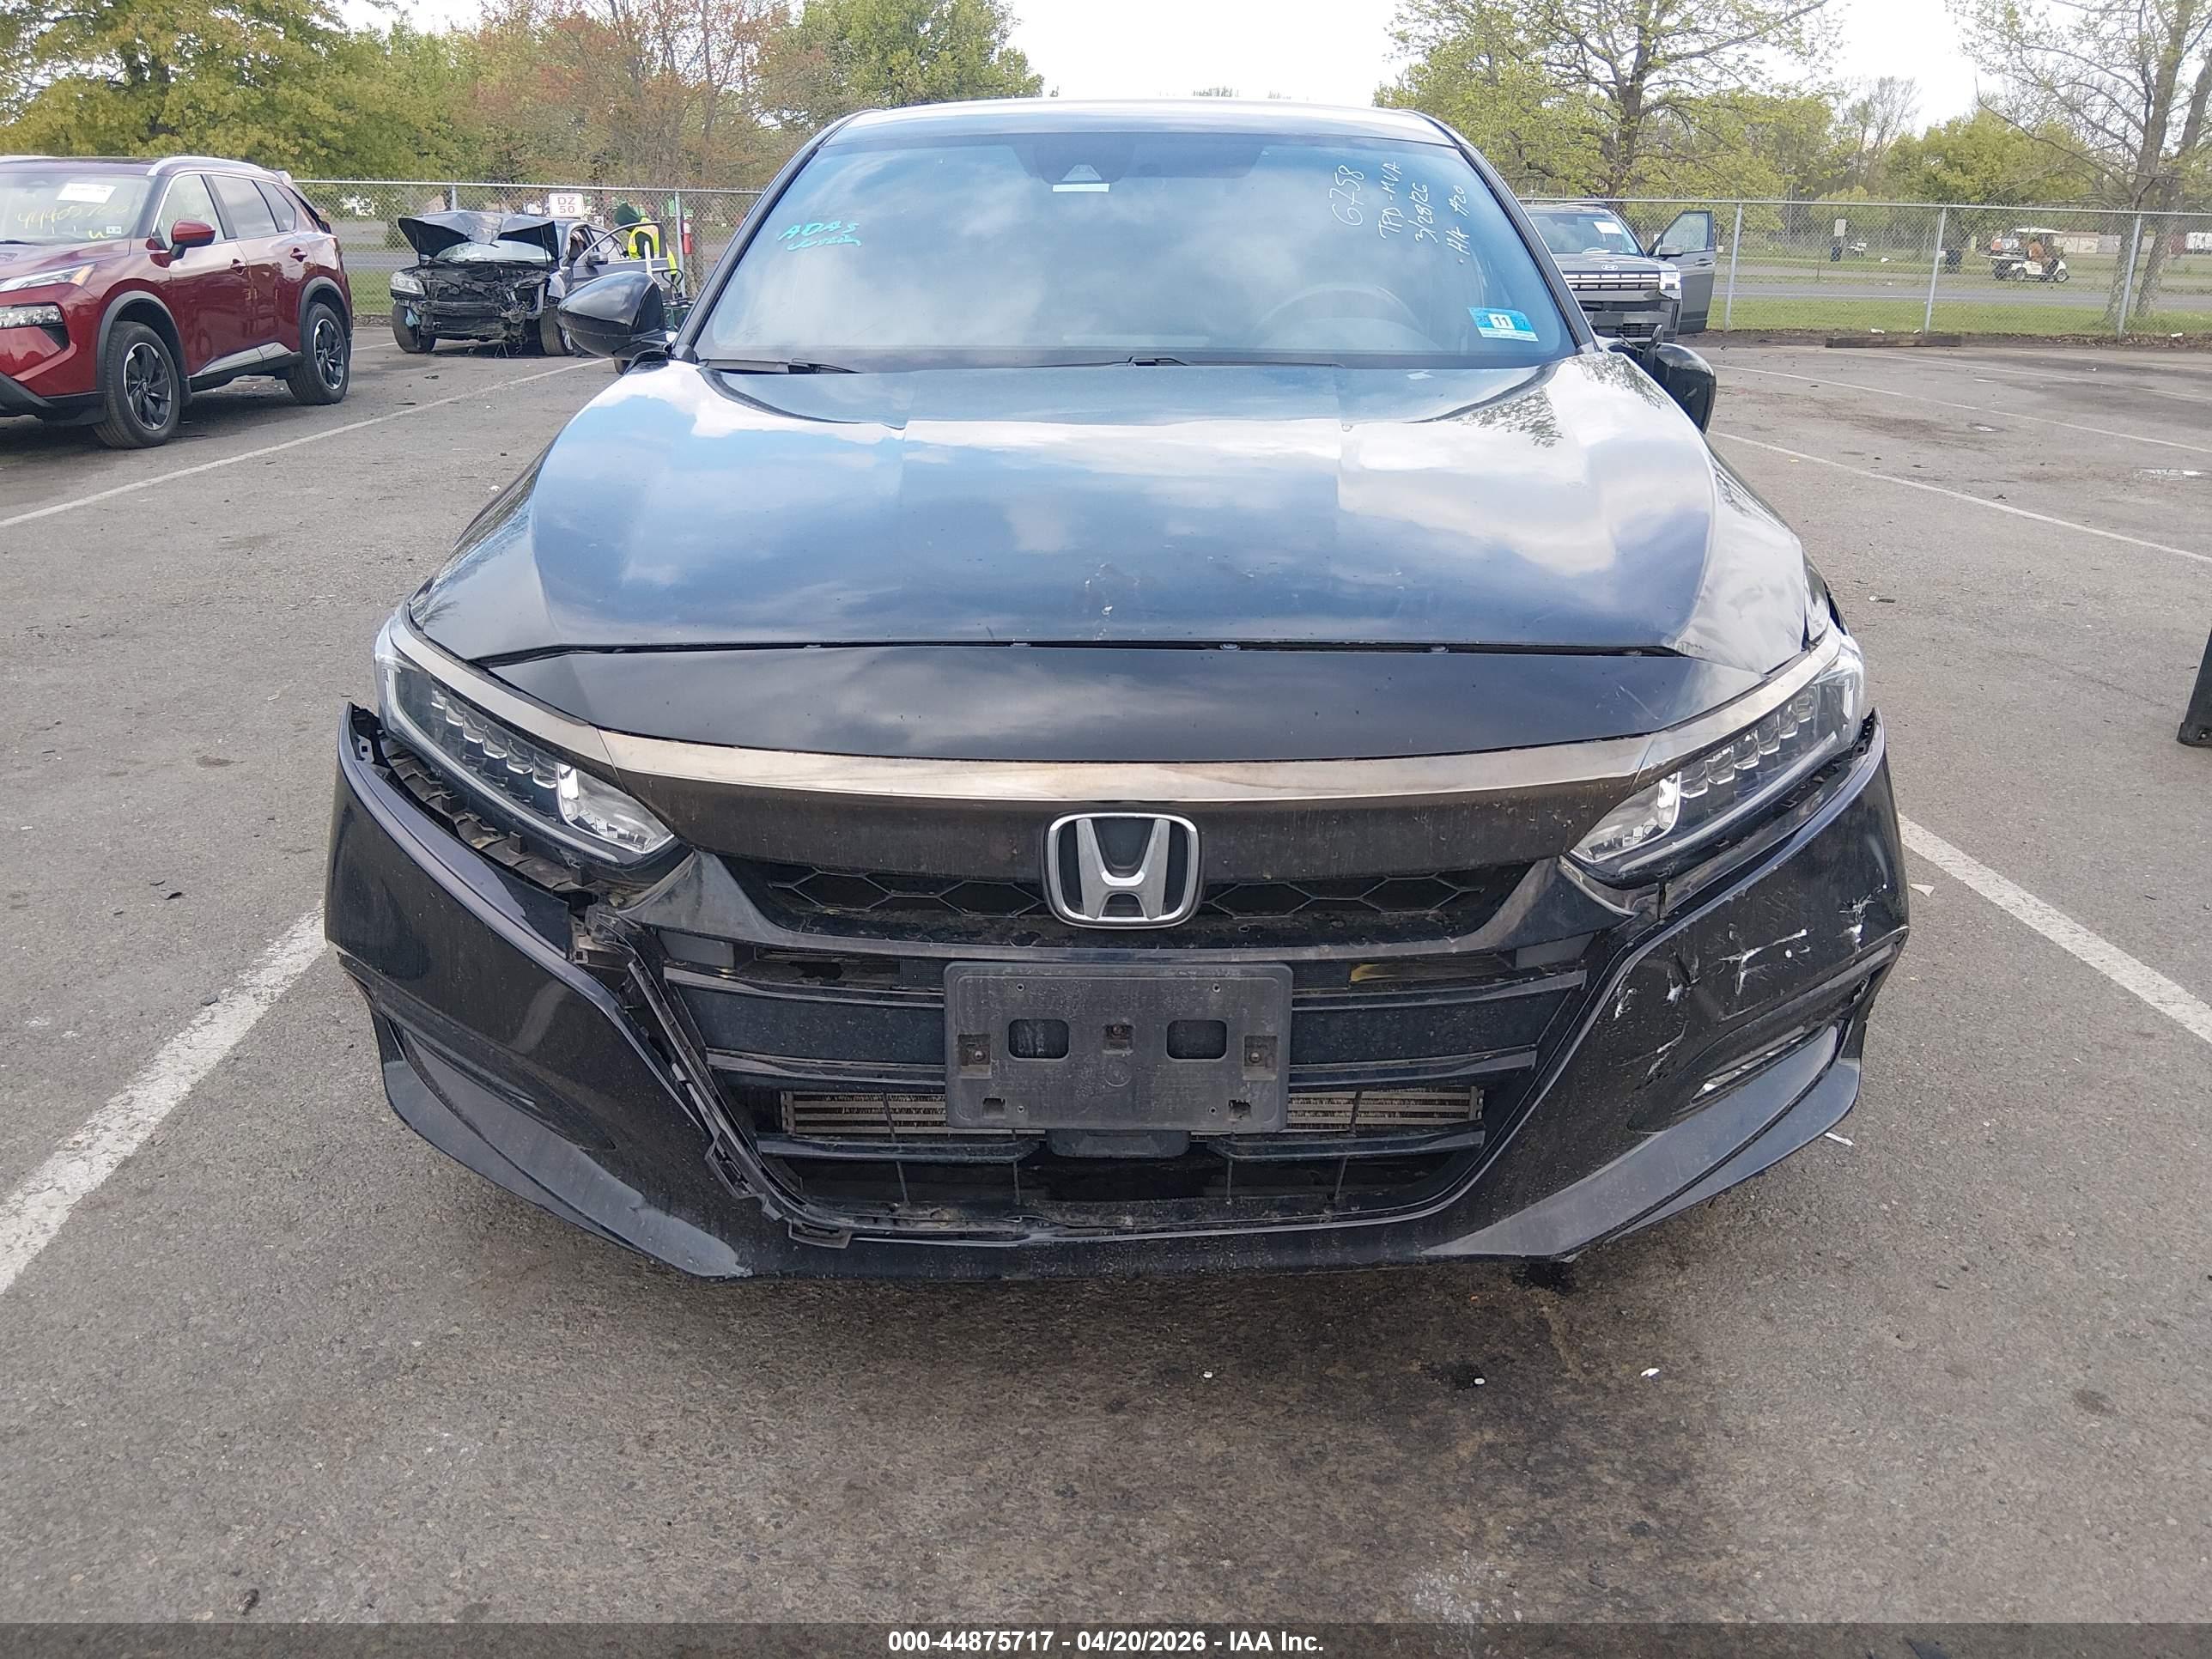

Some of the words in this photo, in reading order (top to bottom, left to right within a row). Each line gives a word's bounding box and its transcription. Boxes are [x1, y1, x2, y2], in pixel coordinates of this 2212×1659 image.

[557, 197, 576, 205] DZ
[559, 205, 574, 214] 50
[1407, 182, 1438, 244] 3/28/26
[1494, 316, 1510, 327] 11
